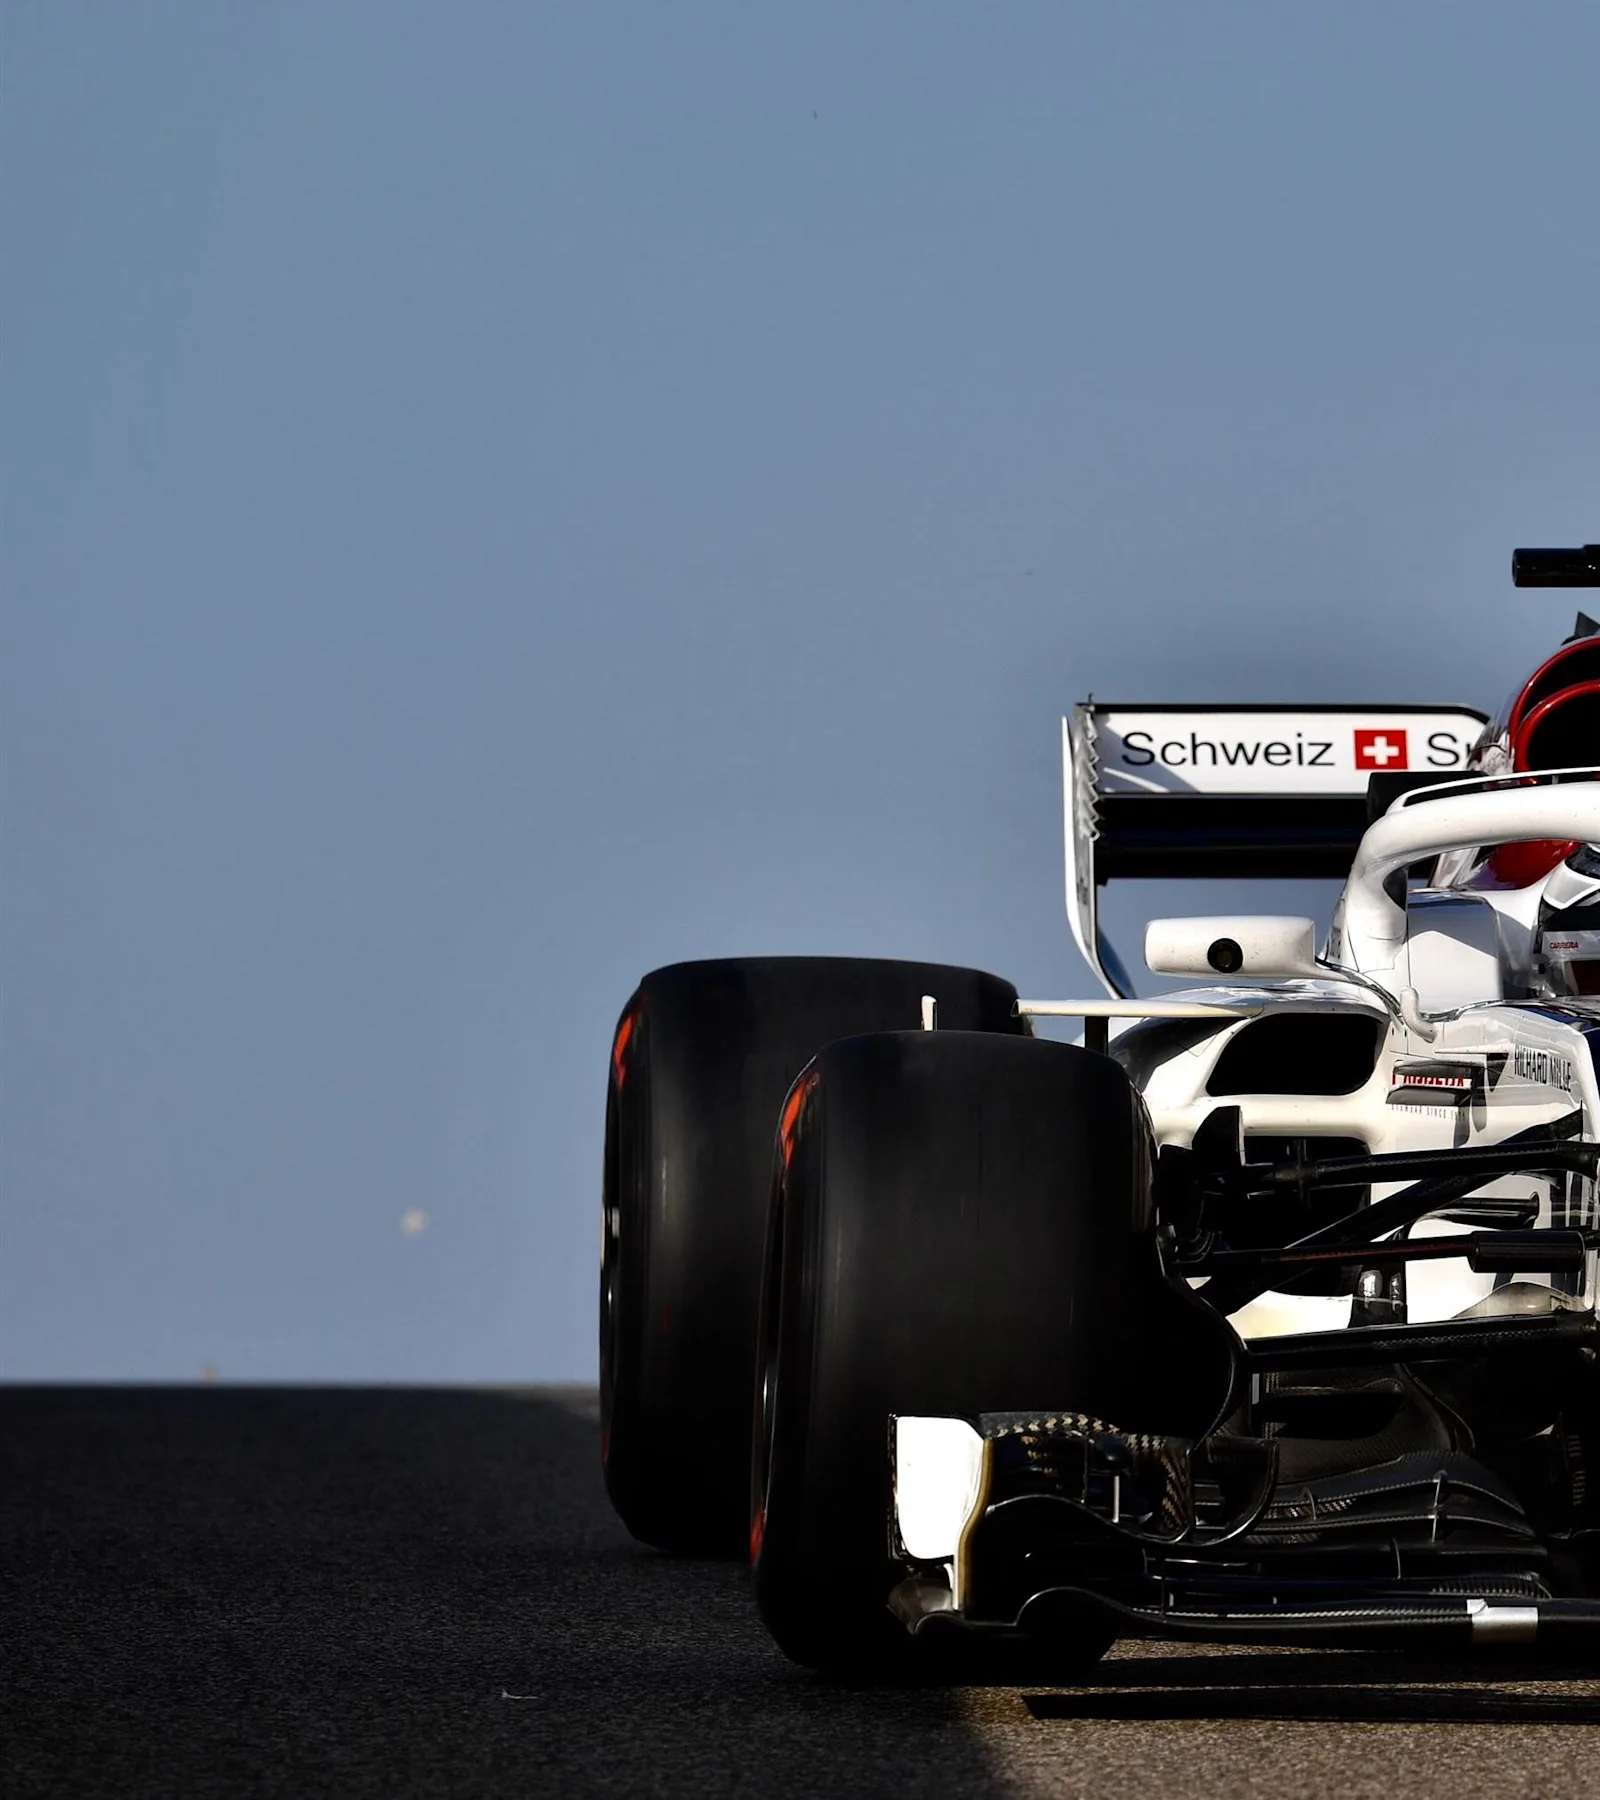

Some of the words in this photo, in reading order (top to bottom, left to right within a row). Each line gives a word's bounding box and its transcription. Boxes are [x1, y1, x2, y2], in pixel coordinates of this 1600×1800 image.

[1121, 731, 1335, 767] Schweiz
[1514, 1045, 1548, 1085] RICHARD
[1549, 1056, 1571, 1093] MILLE
